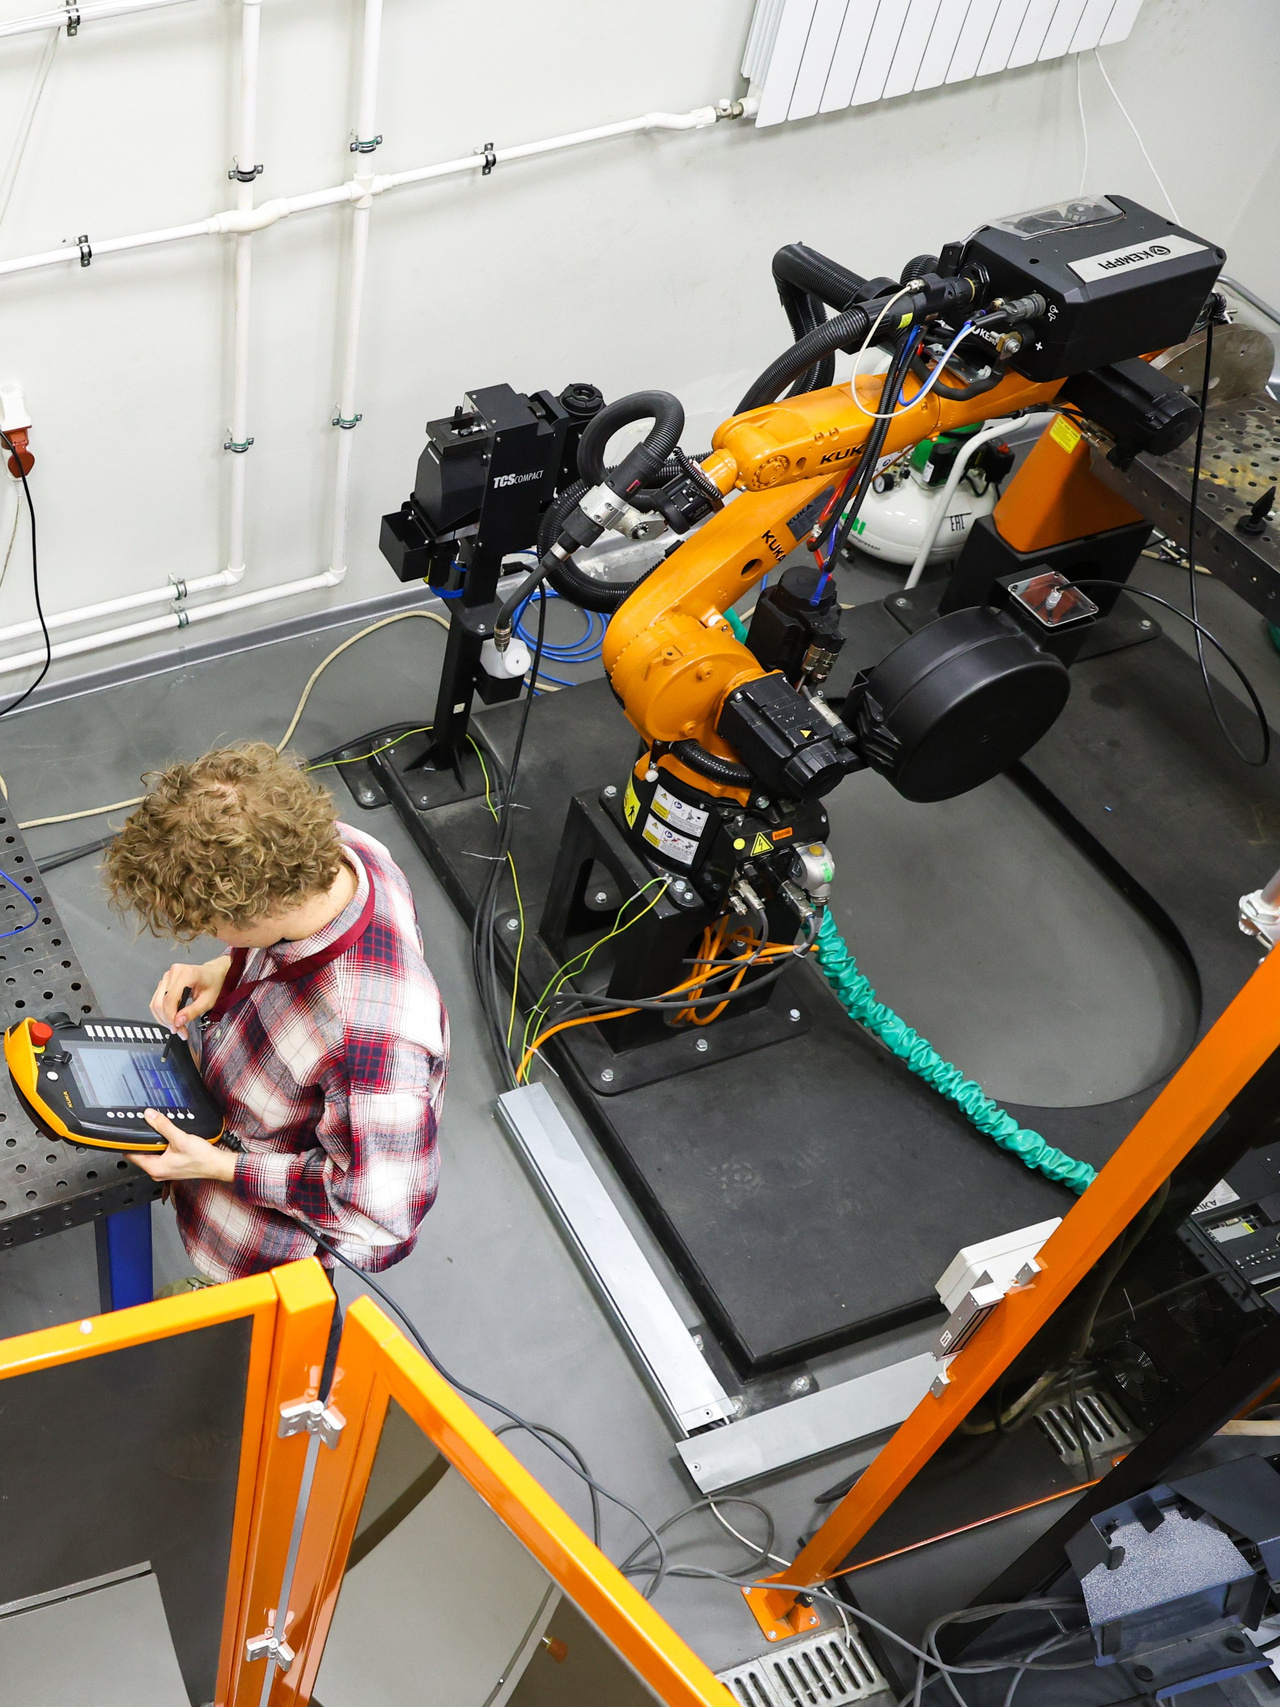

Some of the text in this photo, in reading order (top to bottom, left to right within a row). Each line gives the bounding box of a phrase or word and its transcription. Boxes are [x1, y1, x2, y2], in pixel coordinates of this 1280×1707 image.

[1098, 250, 1154, 270] KEMPPI
[820, 442, 866, 465] KUK
[786, 504, 813, 527] KUKA
[761, 529, 787, 564] KUKA
